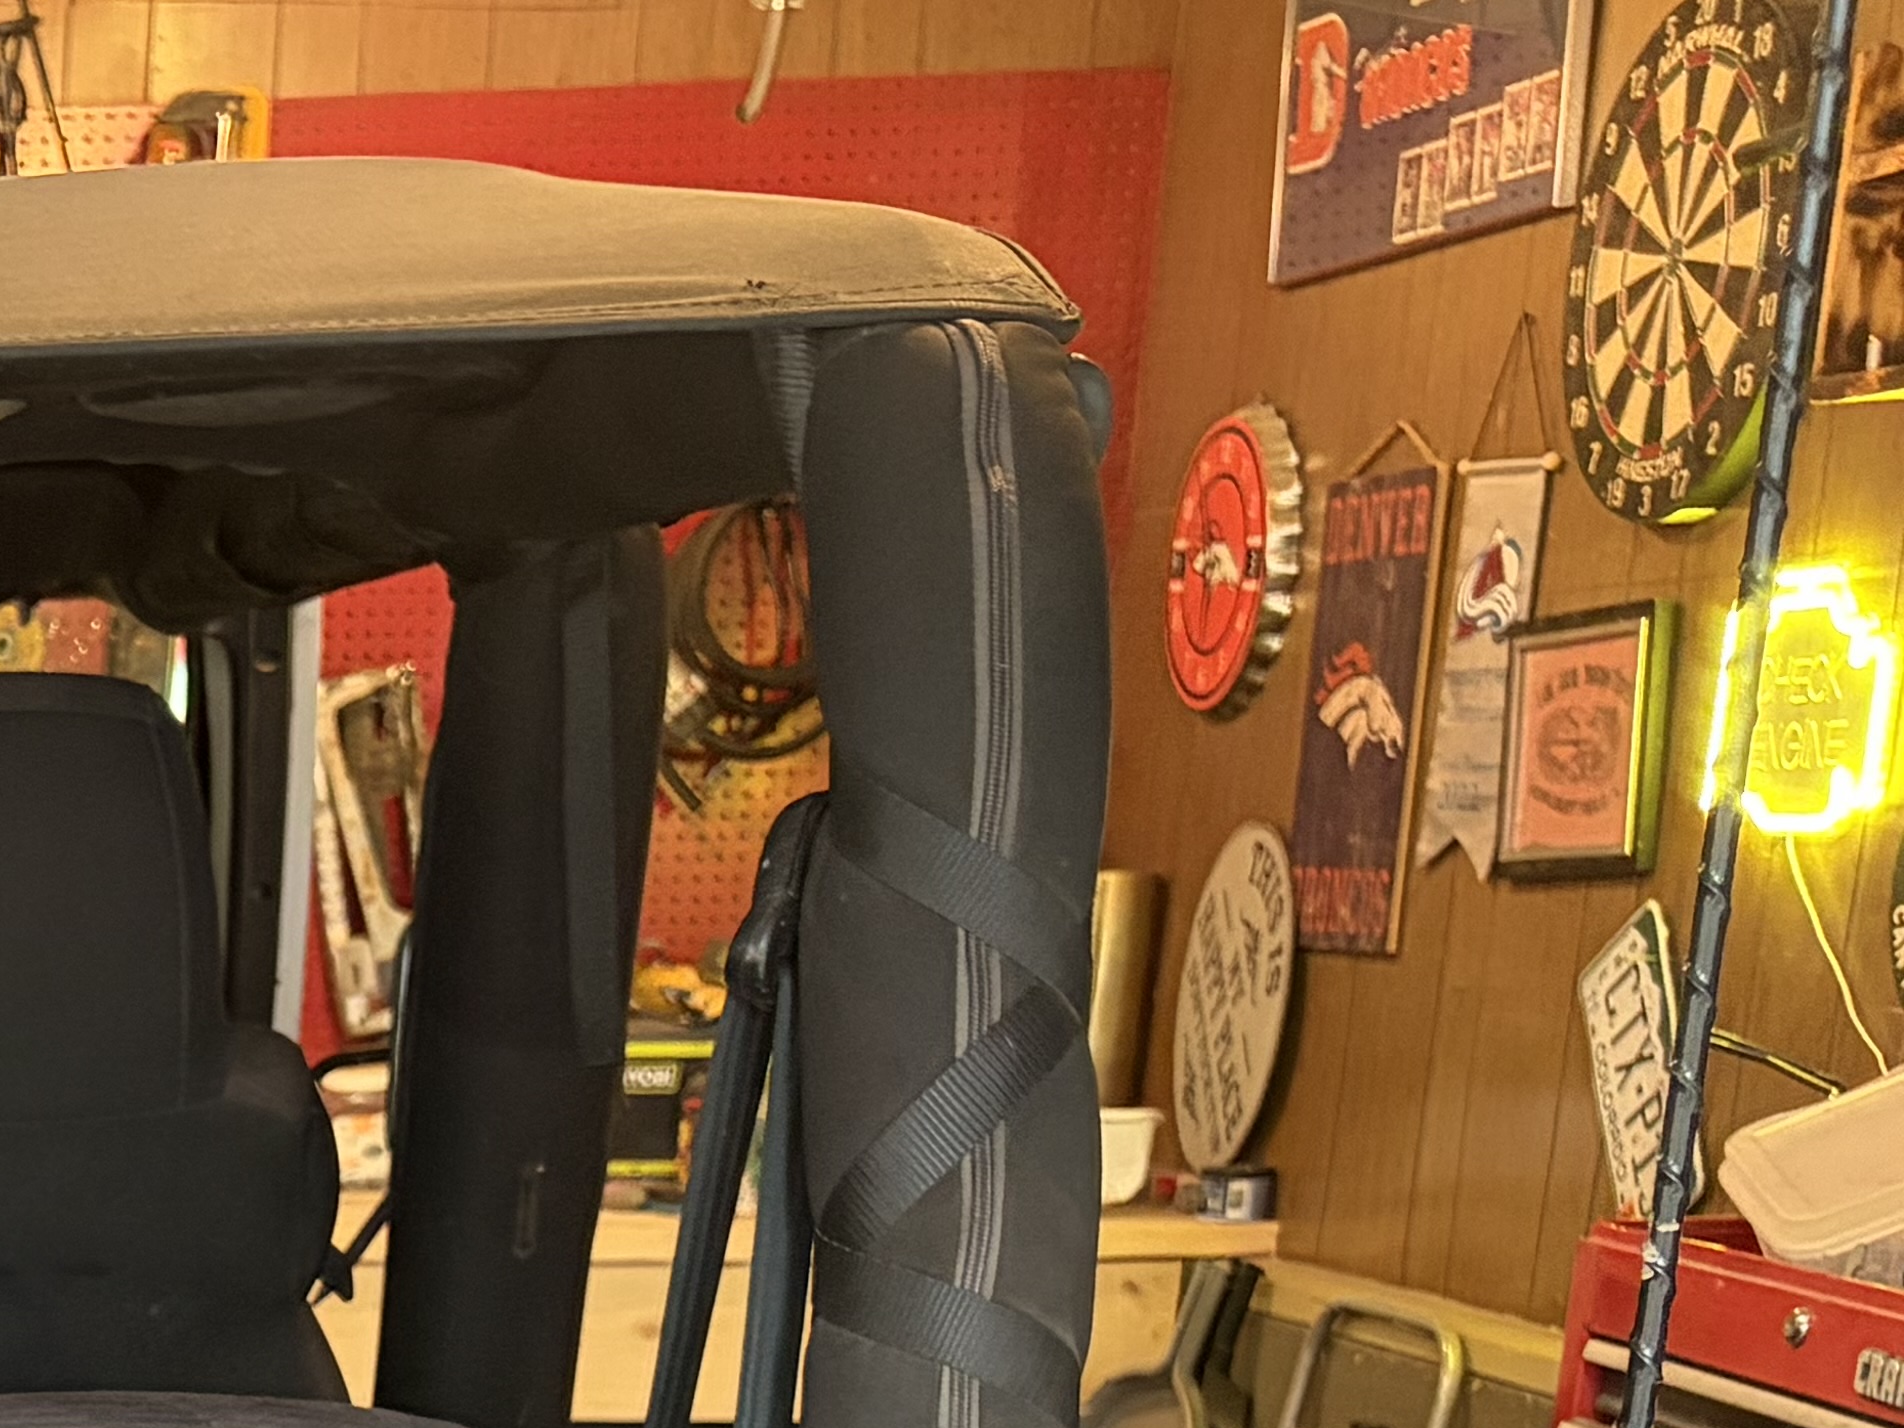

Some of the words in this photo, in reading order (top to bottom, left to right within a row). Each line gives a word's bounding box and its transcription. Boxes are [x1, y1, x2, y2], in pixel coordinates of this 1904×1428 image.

[1630, 66, 1650, 99] 12
[1758, 292, 1778, 327] 10
[1733, 363, 1754, 398] 15
[1705, 421, 1722, 456] 2
[1638, 485, 1653, 517] 3
[1266, 942, 1283, 998] IS
